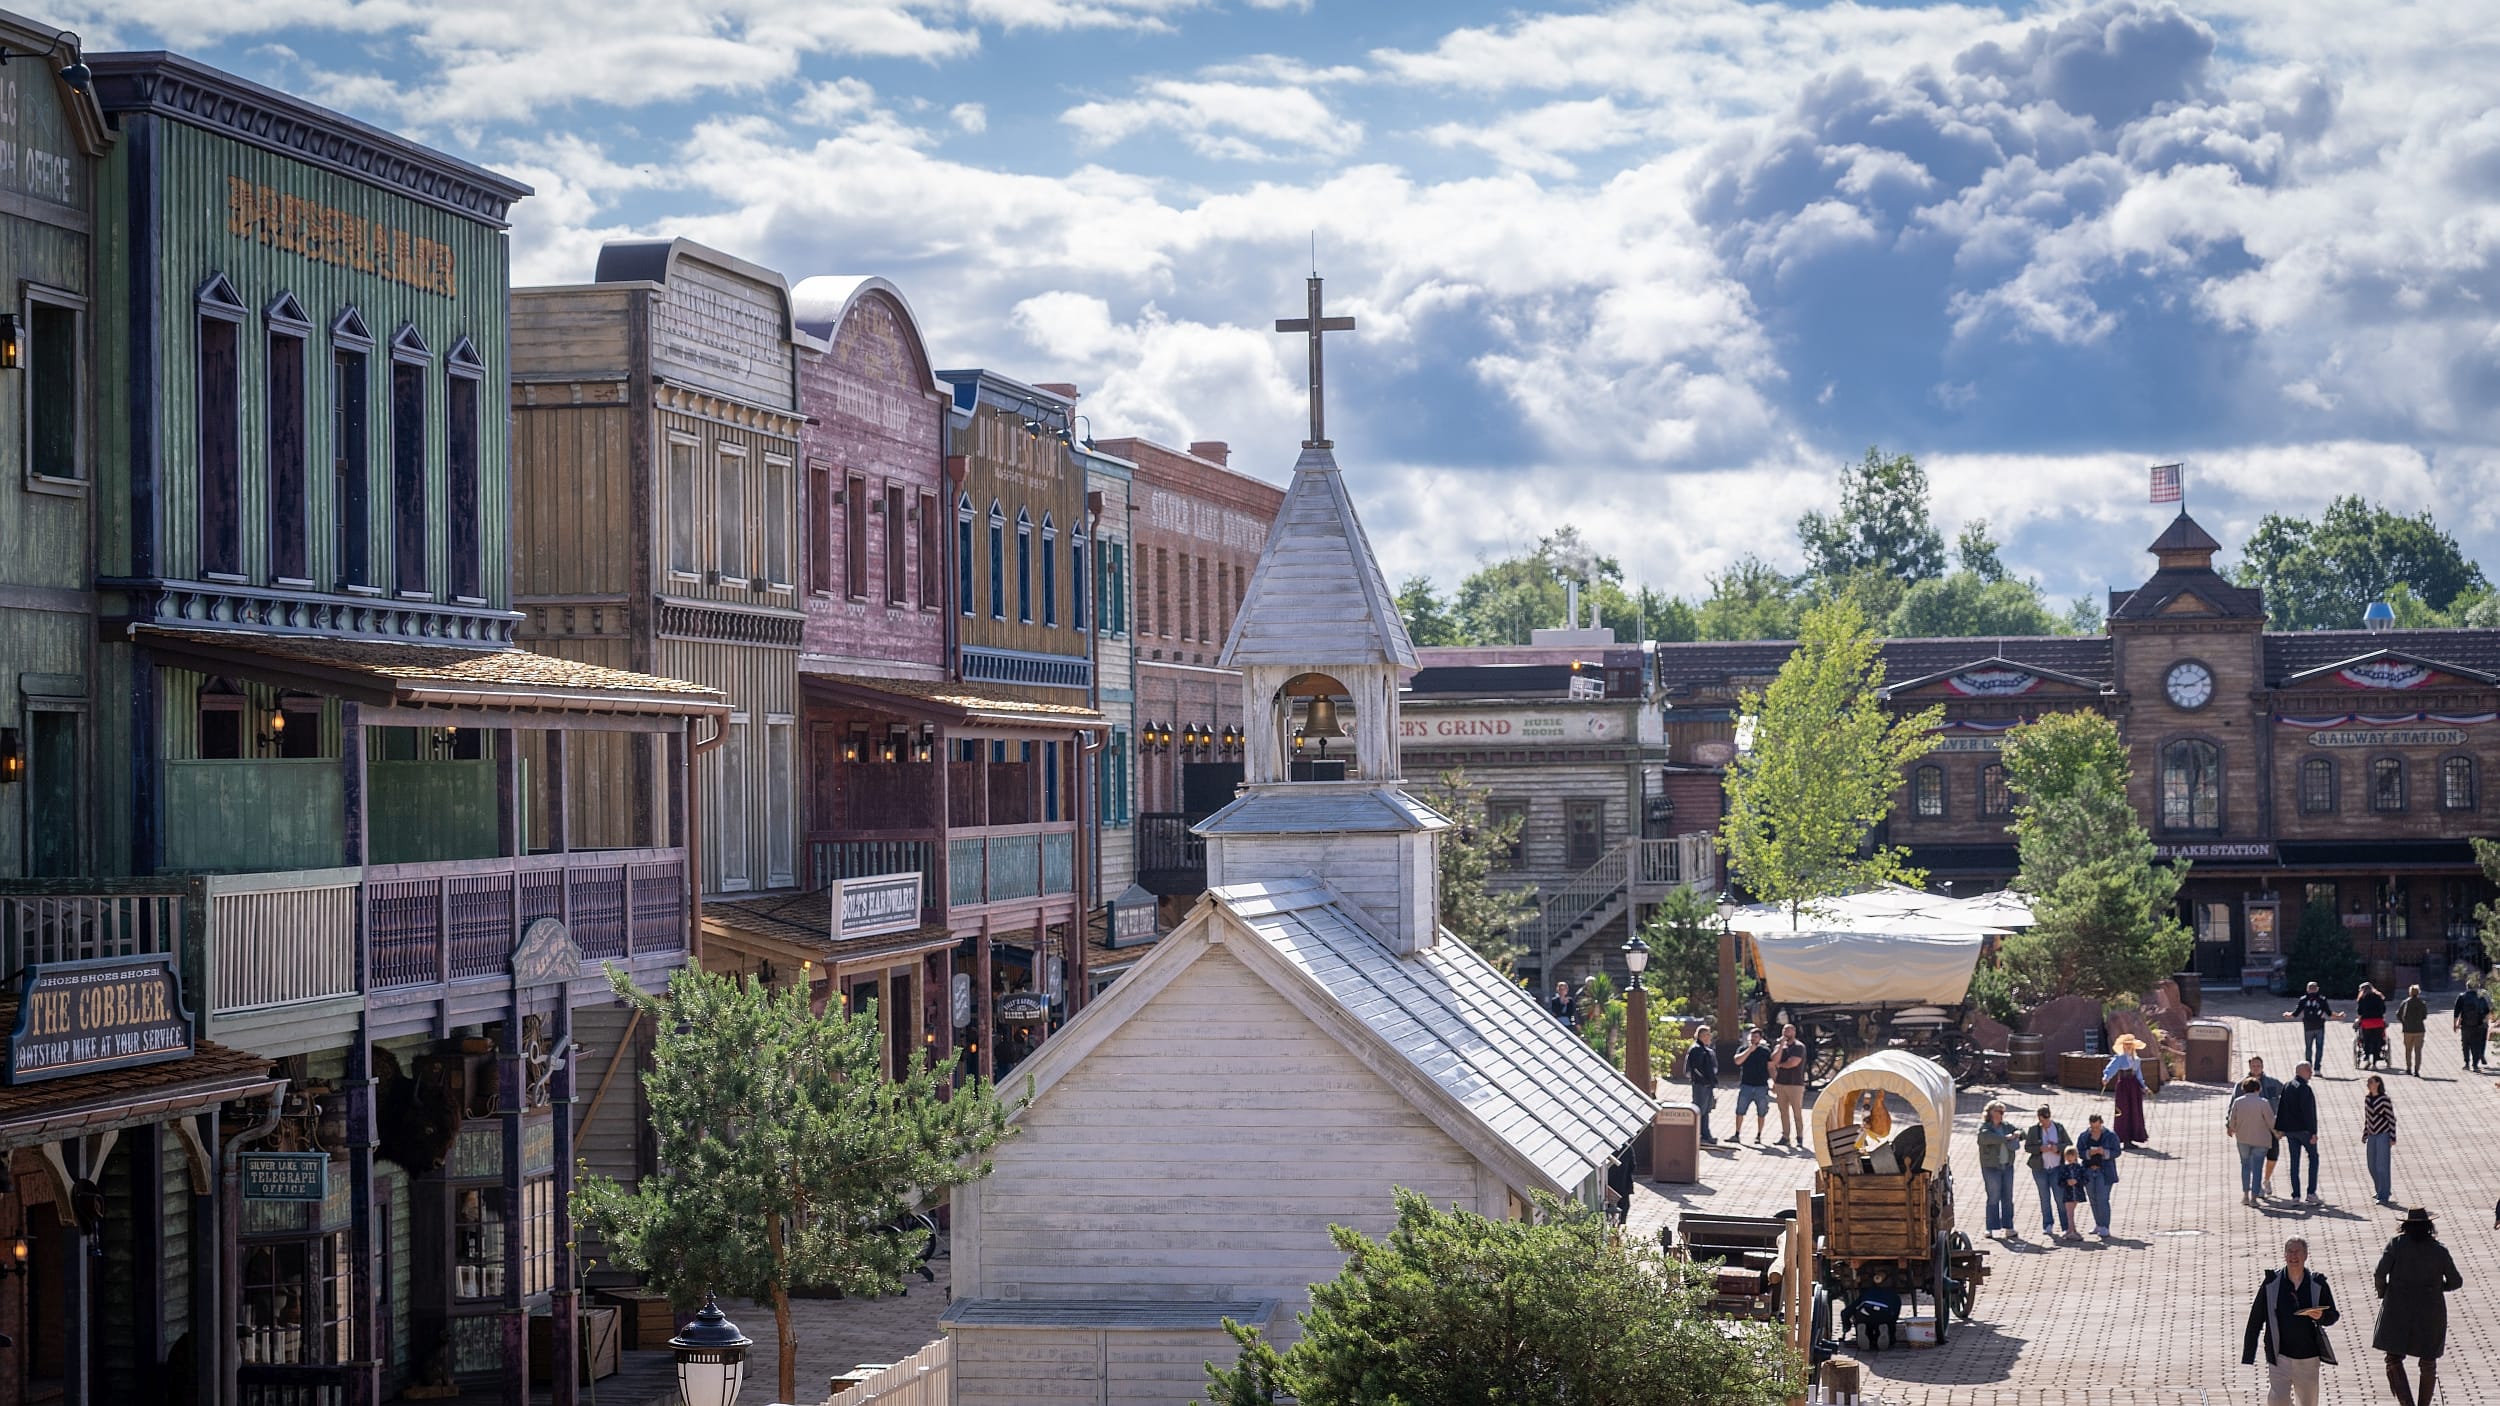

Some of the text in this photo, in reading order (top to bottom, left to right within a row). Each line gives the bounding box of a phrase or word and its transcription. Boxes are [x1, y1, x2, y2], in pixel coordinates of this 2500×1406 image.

[0, 78, 17, 126] LC
[26, 147, 70, 202] OFFICE
[1437, 719, 1512, 736] GRIND
[2318, 731, 2457, 745] RAILWAY STATION
[2171, 845, 2208, 857] LAKE
[2210, 844, 2270, 856] STATION
[868, 887, 915, 916] HARDWARE
[40, 976, 79, 987] SHOES
[81, 972, 119, 983] SHOES
[31, 980, 172, 1036] THE COBBLER.
[72, 1036, 98, 1061] MIKE
[100, 1035, 112, 1056] AT
[115, 1031, 140, 1055] YOUR
[143, 1026, 185, 1051] SERVICE.
[249, 1161, 319, 1171] SILVER LAKE CITY
[251, 1171, 316, 1184] TELEGRAPH
[262, 1184, 306, 1193] OFFICE
